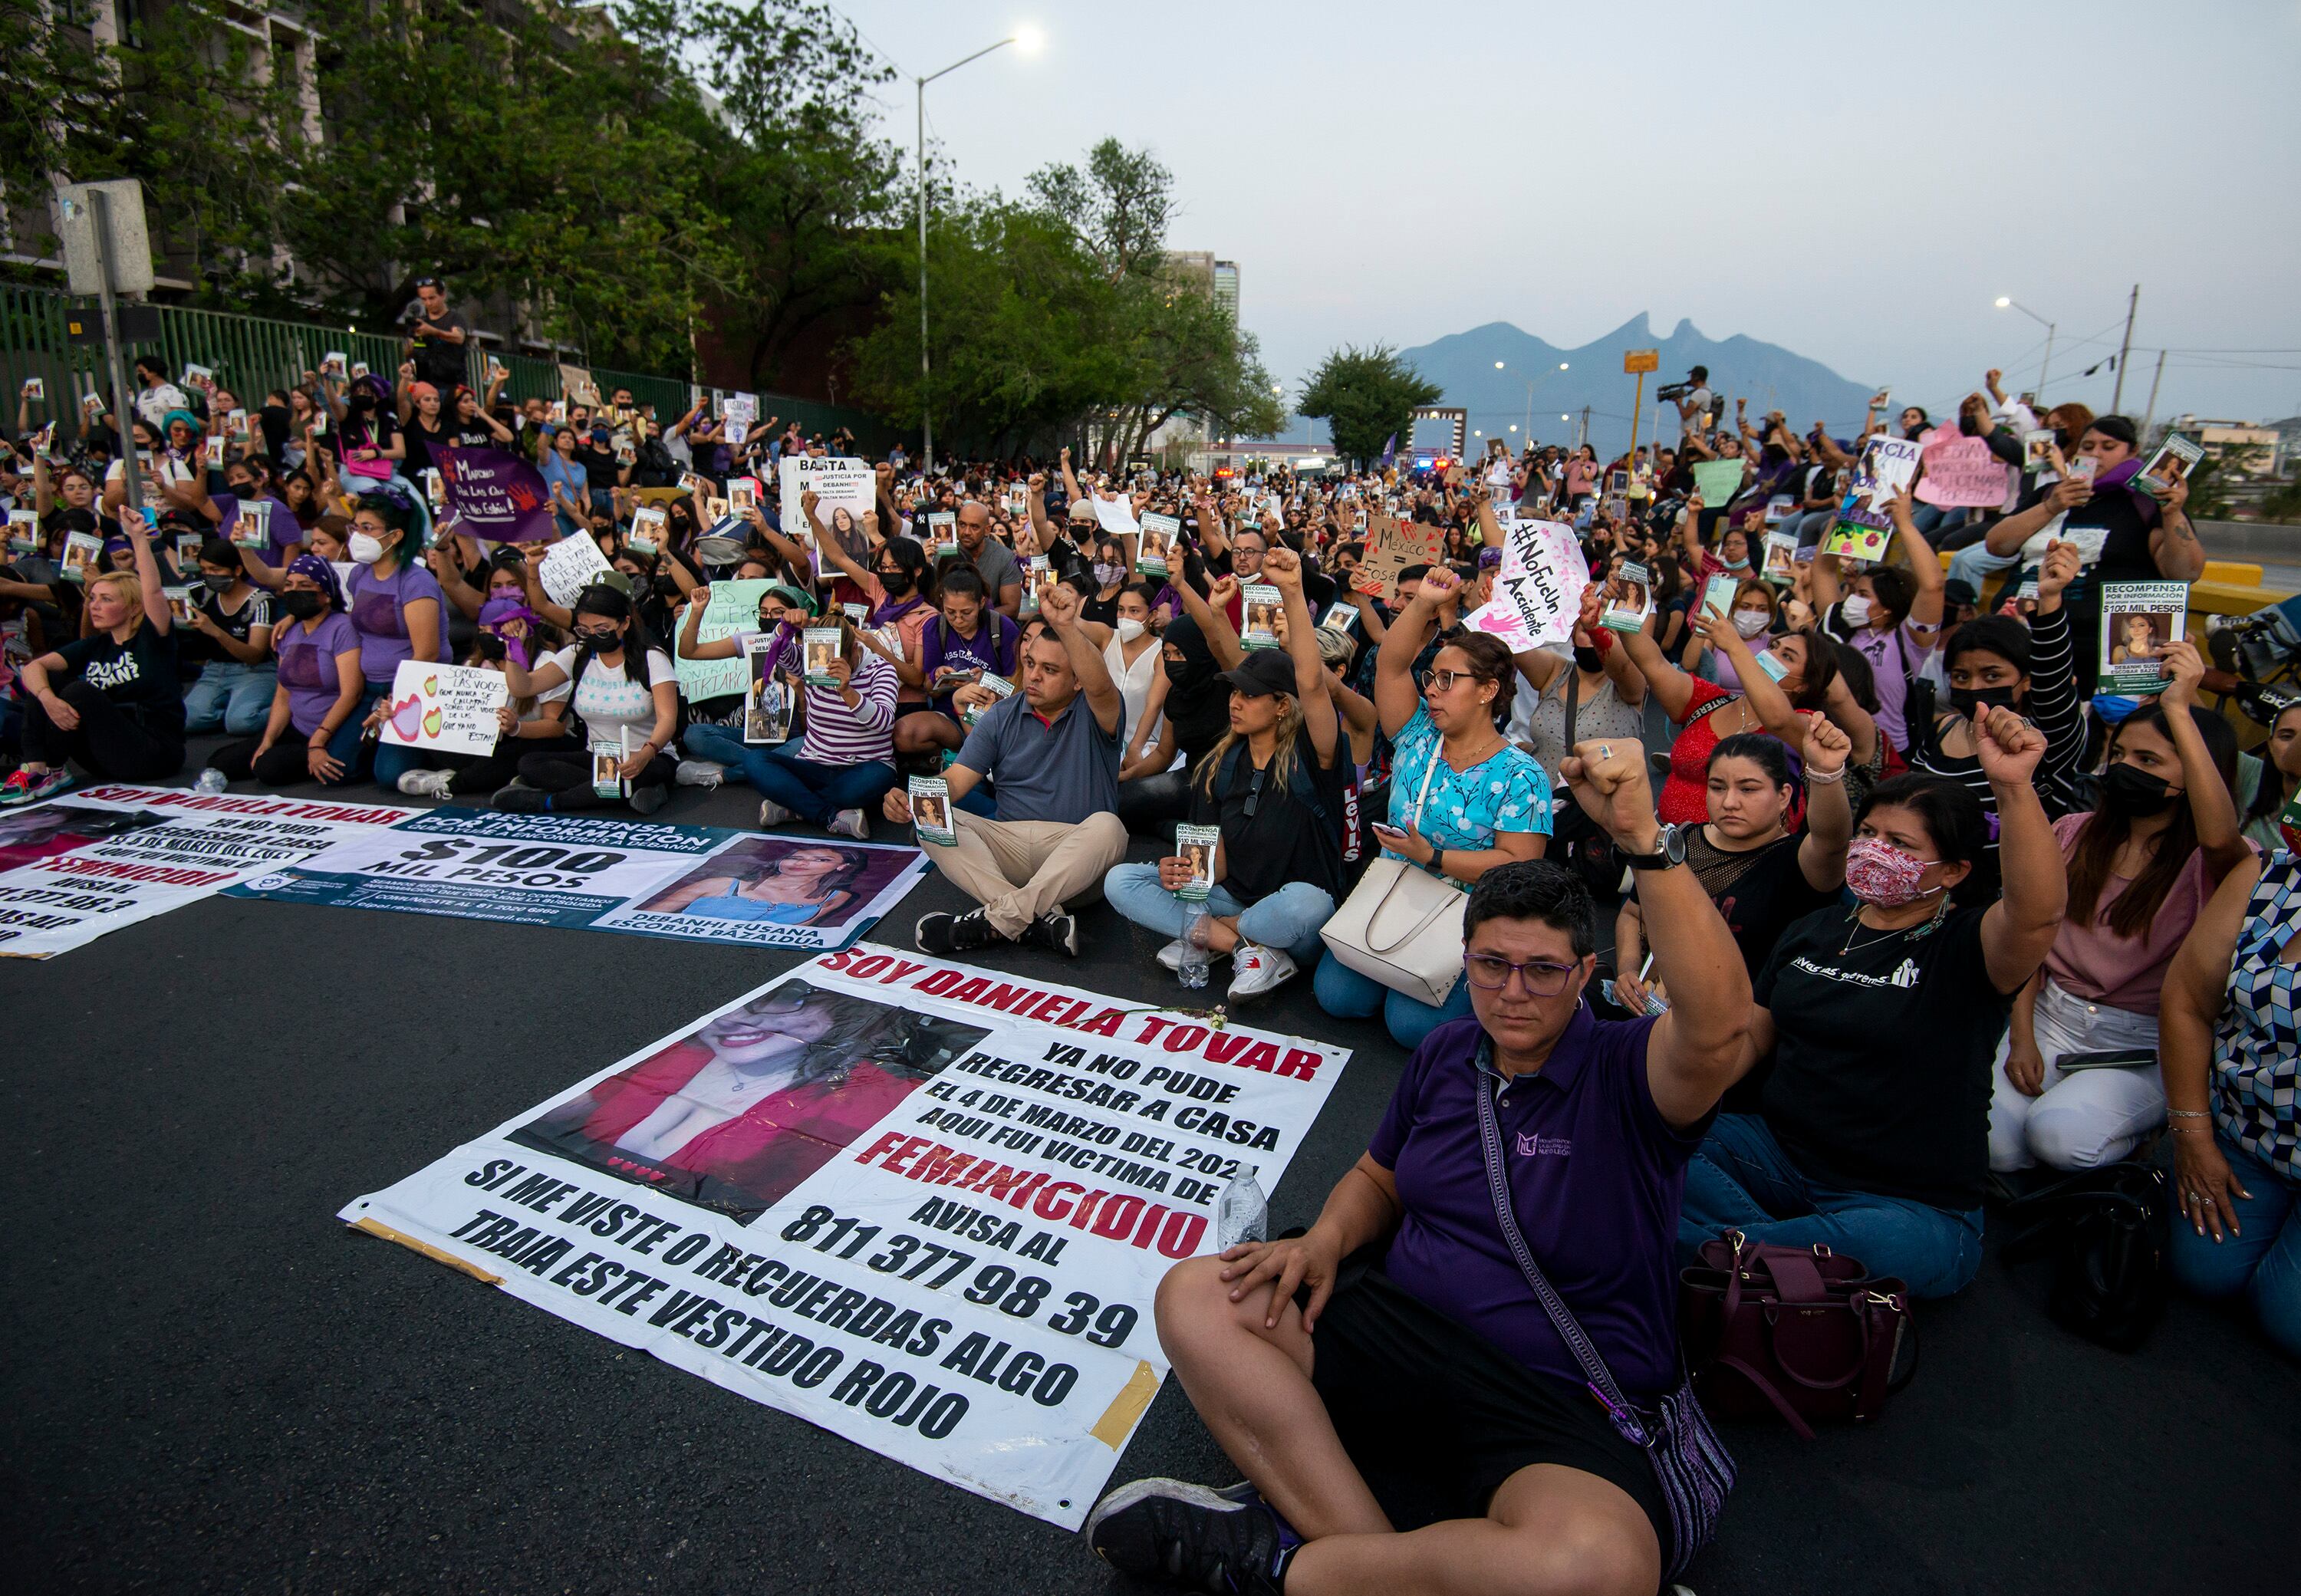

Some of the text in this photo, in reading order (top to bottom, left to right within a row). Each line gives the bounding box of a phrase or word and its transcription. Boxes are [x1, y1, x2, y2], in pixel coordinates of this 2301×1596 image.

[1144, 514, 1179, 525] RECOMPENSA
[1379, 528, 1425, 556] México
[1364, 560, 1396, 581] Fosa
[1503, 577, 1547, 637] Accidente
[2103, 604, 2126, 613] $100
[2150, 604, 2184, 613] PESOS
[444, 666, 482, 679] SOMOS
[453, 680, 471, 689] LAS
[985, 673, 1013, 689] RECOMPENSA
[77, 786, 158, 803] SOY
[283, 803, 412, 825] TOVAR
[265, 822, 334, 837] PUDE
[416, 816, 712, 847] POR INFORMACIÓN
[477, 811, 676, 834] RECOMPENSA
[266, 836, 337, 851] CASA
[407, 824, 446, 833] QUE
[510, 831, 613, 844] ENCONTRAR
[626, 839, 703, 851] DEBANHI
[399, 837, 628, 874] $100
[47, 877, 142, 894] AVISA AL
[357, 860, 591, 889] MIL PESOS
[55, 894, 114, 913] 98
[461, 890, 526, 903] COMPLIQUE
[495, 904, 528, 913] 2020
[526, 891, 614, 906] COMPARTAMOS
[607, 919, 825, 947] ESCOBAR BAZALDUA
[631, 913, 819, 938] DEBANHI SUSANA
[817, 947, 1322, 1083] SOY DANIELA TOVAR
[1042, 1041, 1241, 1104] YA NO PUDE
[956, 1051, 1281, 1153] REGRESAR A CASA
[926, 1080, 959, 1103] EL
[957, 1089, 986, 1108] 4
[983, 1094, 1026, 1118] DE
[1018, 1104, 1121, 1147] MARZO
[1119, 1131, 1176, 1164] DEL
[916, 1107, 1221, 1208] AQUI FUI VICTIMA DE
[852, 1130, 1209, 1260] FEMINICIDIO
[907, 1195, 1071, 1268] AVISA AL
[463, 1158, 1080, 1407] SI ME VISTE O RECUERDAS ALGO
[779, 1203, 1140, 1350] 811 377 98 39
[449, 1208, 970, 1440] TRAIA ESTE VESTIDO ROJO
